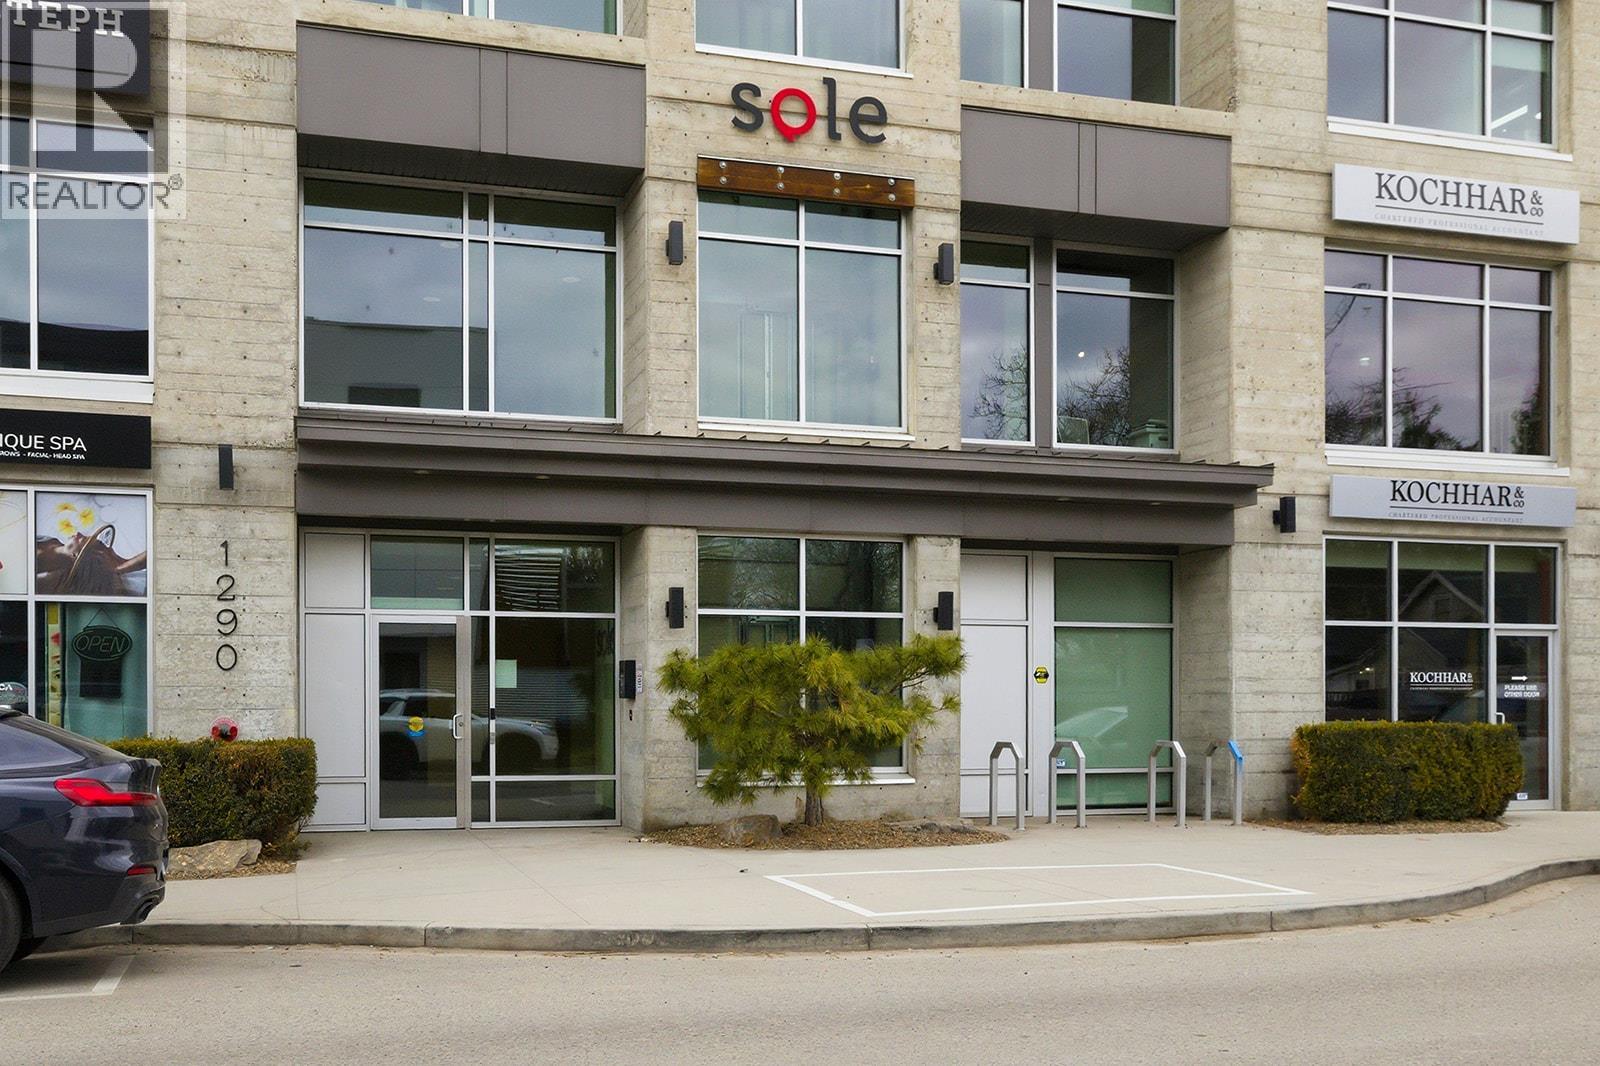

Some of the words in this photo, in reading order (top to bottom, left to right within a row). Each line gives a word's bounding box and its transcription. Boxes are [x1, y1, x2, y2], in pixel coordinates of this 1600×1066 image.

[0, 0, 125, 38] TEPH
[730, 76, 888, 144] sole
[1375, 172, 1528, 216] KOCHHAR
[50, 435, 87, 452] SPA
[1390, 479, 1513, 507] KOCHHAR
[75, 633, 126, 654] OPEN
[1409, 671, 1467, 683] KOCHHAR
